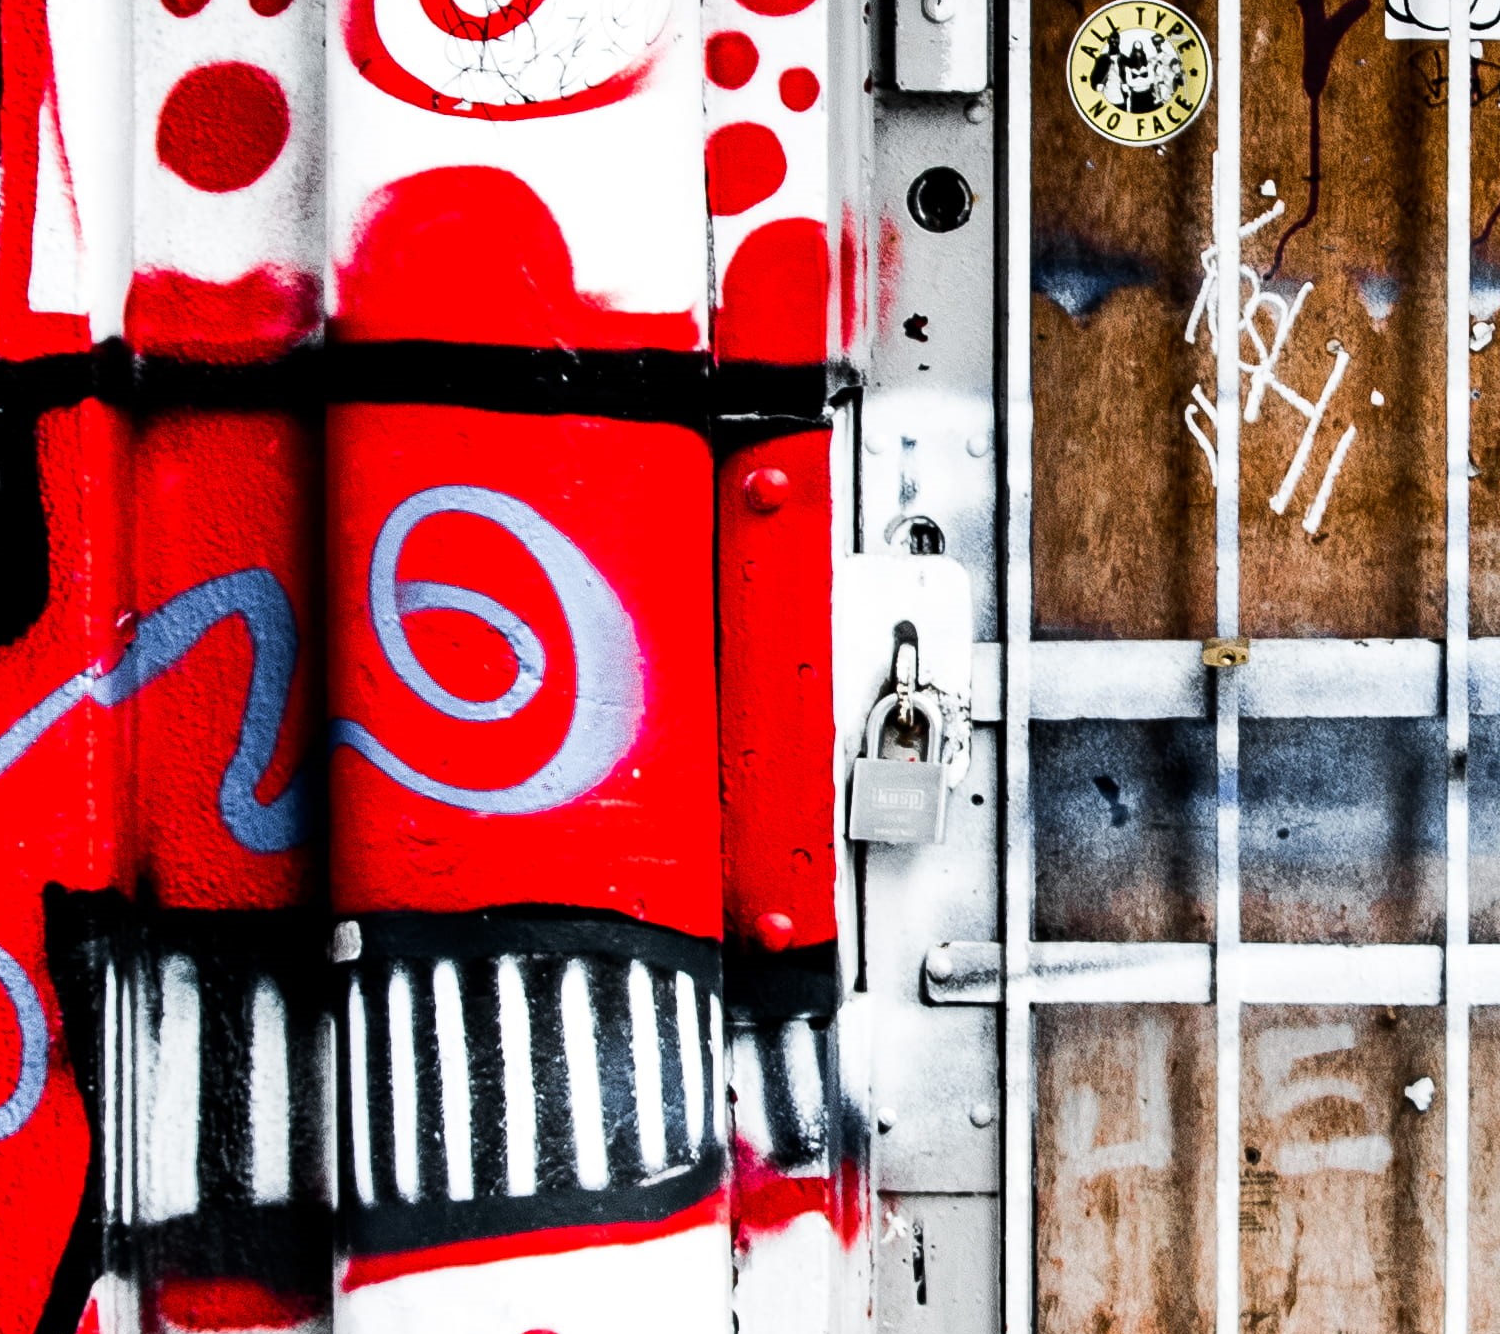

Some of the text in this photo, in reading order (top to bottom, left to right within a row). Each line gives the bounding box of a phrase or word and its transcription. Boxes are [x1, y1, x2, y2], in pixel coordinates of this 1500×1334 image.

[1080, 7, 1197, 60] ALL TYPE
[1088, 94, 1194, 137] NO FACE
